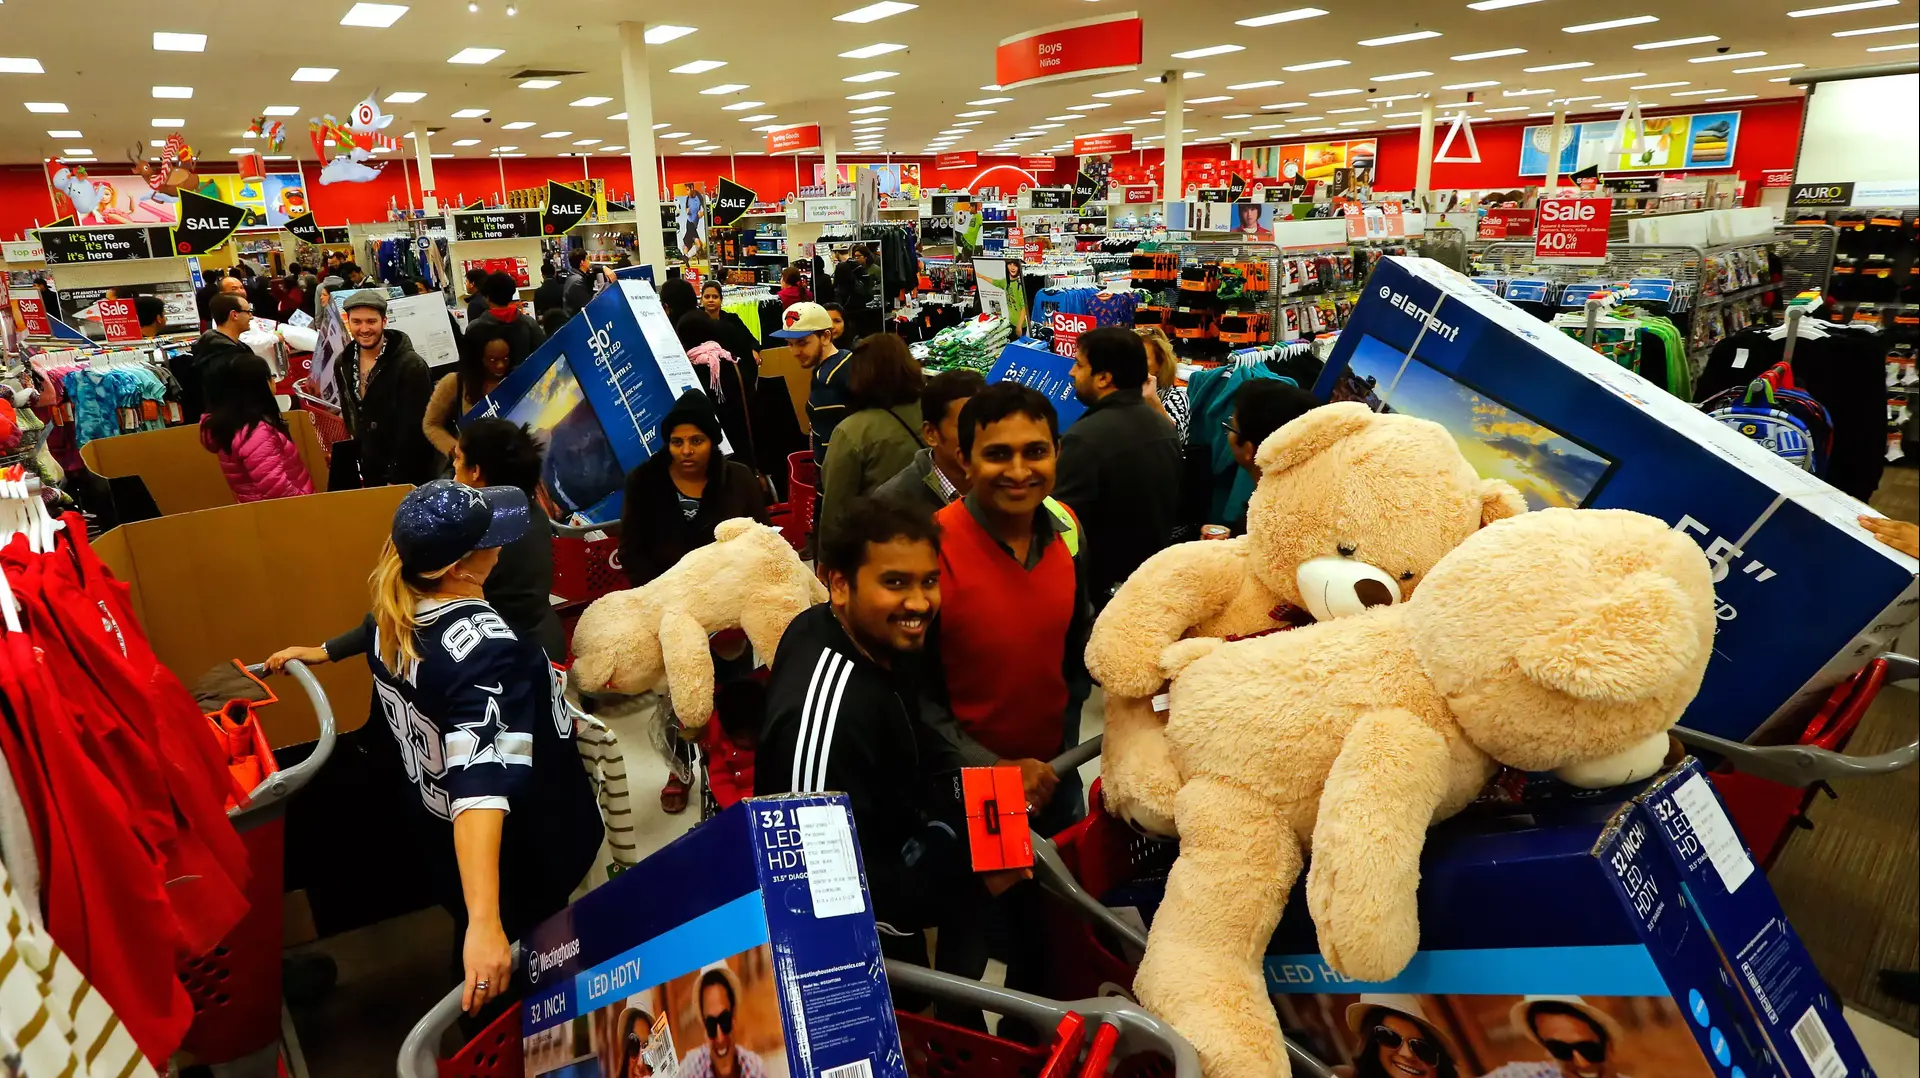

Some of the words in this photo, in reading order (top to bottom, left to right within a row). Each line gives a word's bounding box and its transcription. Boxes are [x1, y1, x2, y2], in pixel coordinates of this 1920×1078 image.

[1039, 42, 1062, 55] Boys
[1040, 57, 1061, 68] Niños
[1076, 187, 1092, 195] SALE
[1796, 186, 1842, 199] AURO
[551, 204, 582, 215] SALE
[720, 198, 746, 208] SALE
[1343, 203, 1359, 215] Sale
[1383, 203, 1398, 215] Sale
[1541, 200, 1596, 221] Sale
[186, 217, 231, 231] SALE
[473, 215, 485, 223] it's
[1481, 216, 1502, 225] Sale
[293, 225, 315, 234] SALE
[484, 230, 503, 238] here
[1008, 227, 1020, 236] Sale
[68, 233, 87, 242] it's
[88, 232, 115, 241] here
[32, 248, 44, 256] gif
[84, 242, 102, 250] it's
[104, 241, 130, 249] here
[1024, 243, 1039, 252] Sale
[1565, 242, 1577, 250] off
[67, 252, 85, 260] it's
[87, 251, 113, 260] here
[685, 268, 696, 280] Sale
[20, 300, 39, 313] Sale
[100, 301, 129, 316] Sale
[1054, 314, 1088, 334] Sale
[1390, 292, 1460, 343] element
[587, 320, 614, 357] 50"
[609, 340, 621, 354] LED
[440, 611, 519, 663] 82
[373, 673, 453, 823] 82
[1655, 798, 1676, 821] 32
[760, 809, 786, 829] 32
[1665, 812, 1692, 841] LED
[764, 829, 802, 849] LED
[1676, 830, 1698, 861] HD
[1611, 851, 1629, 877] 32
[1621, 823, 1646, 862] INCH
[767, 848, 806, 871] HDT
[772, 875, 788, 883] 31.5"
[788, 872, 809, 881] DIAGO
[1622, 865, 1643, 898] LED
[1633, 874, 1659, 920] HDTV
[540, 938, 580, 973] Westinghouse
[588, 973, 609, 1000] LED
[610, 957, 641, 991] HDTV
[1268, 964, 1314, 984] LED
[530, 1003, 541, 1024] 32
[543, 992, 566, 1019] INCH
